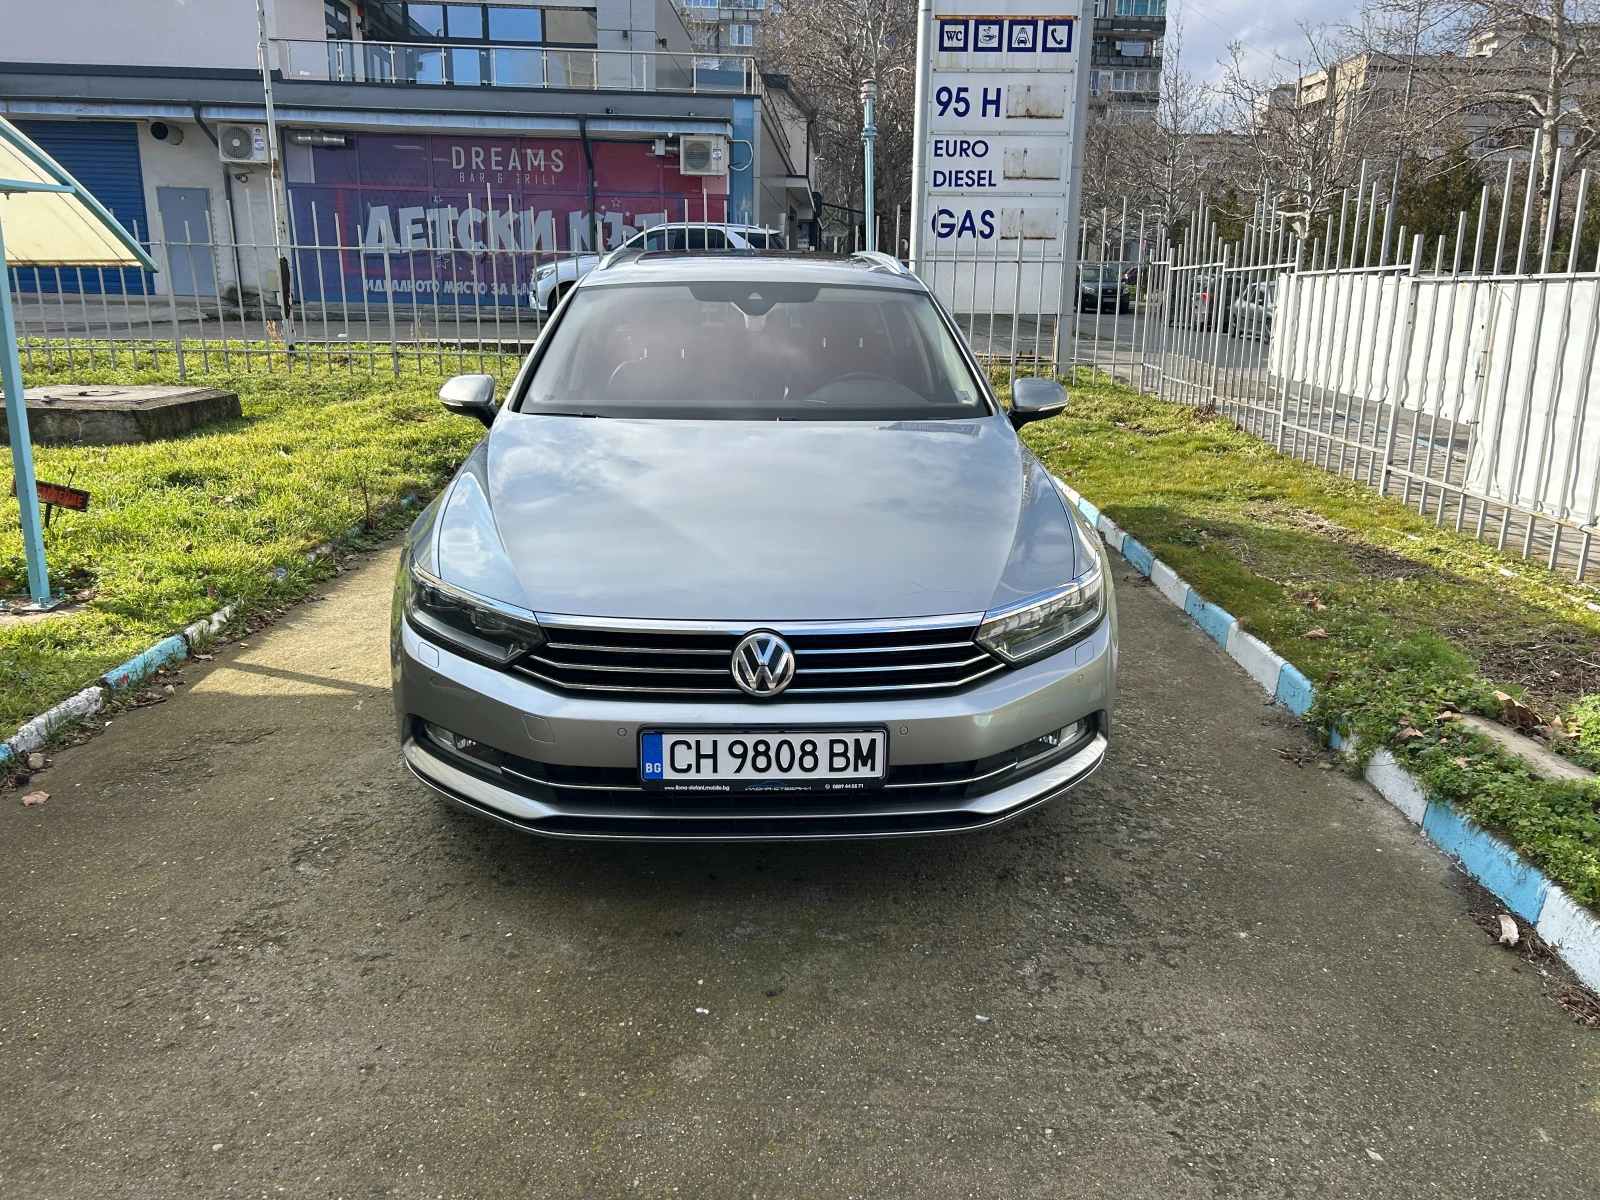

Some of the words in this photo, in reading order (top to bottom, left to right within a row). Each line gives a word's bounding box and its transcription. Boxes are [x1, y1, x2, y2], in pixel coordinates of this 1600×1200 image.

[945, 30, 963, 42] WC
[935, 86, 971, 118] 95
[981, 87, 1002, 118] H
[451, 146, 564, 173] DREAMS
[933, 139, 989, 158] EURO
[459, 171, 486, 183] BAR
[933, 169, 997, 188] DIESEL
[362, 205, 554, 256] ДЕТСКИ
[931, 208, 995, 240] GAS
[490, 282, 509, 296] ЗА
[645, 762, 662, 773] BG
[669, 739, 718, 774] CH
[727, 738, 819, 774] 9808
[828, 737, 877, 773] BM
